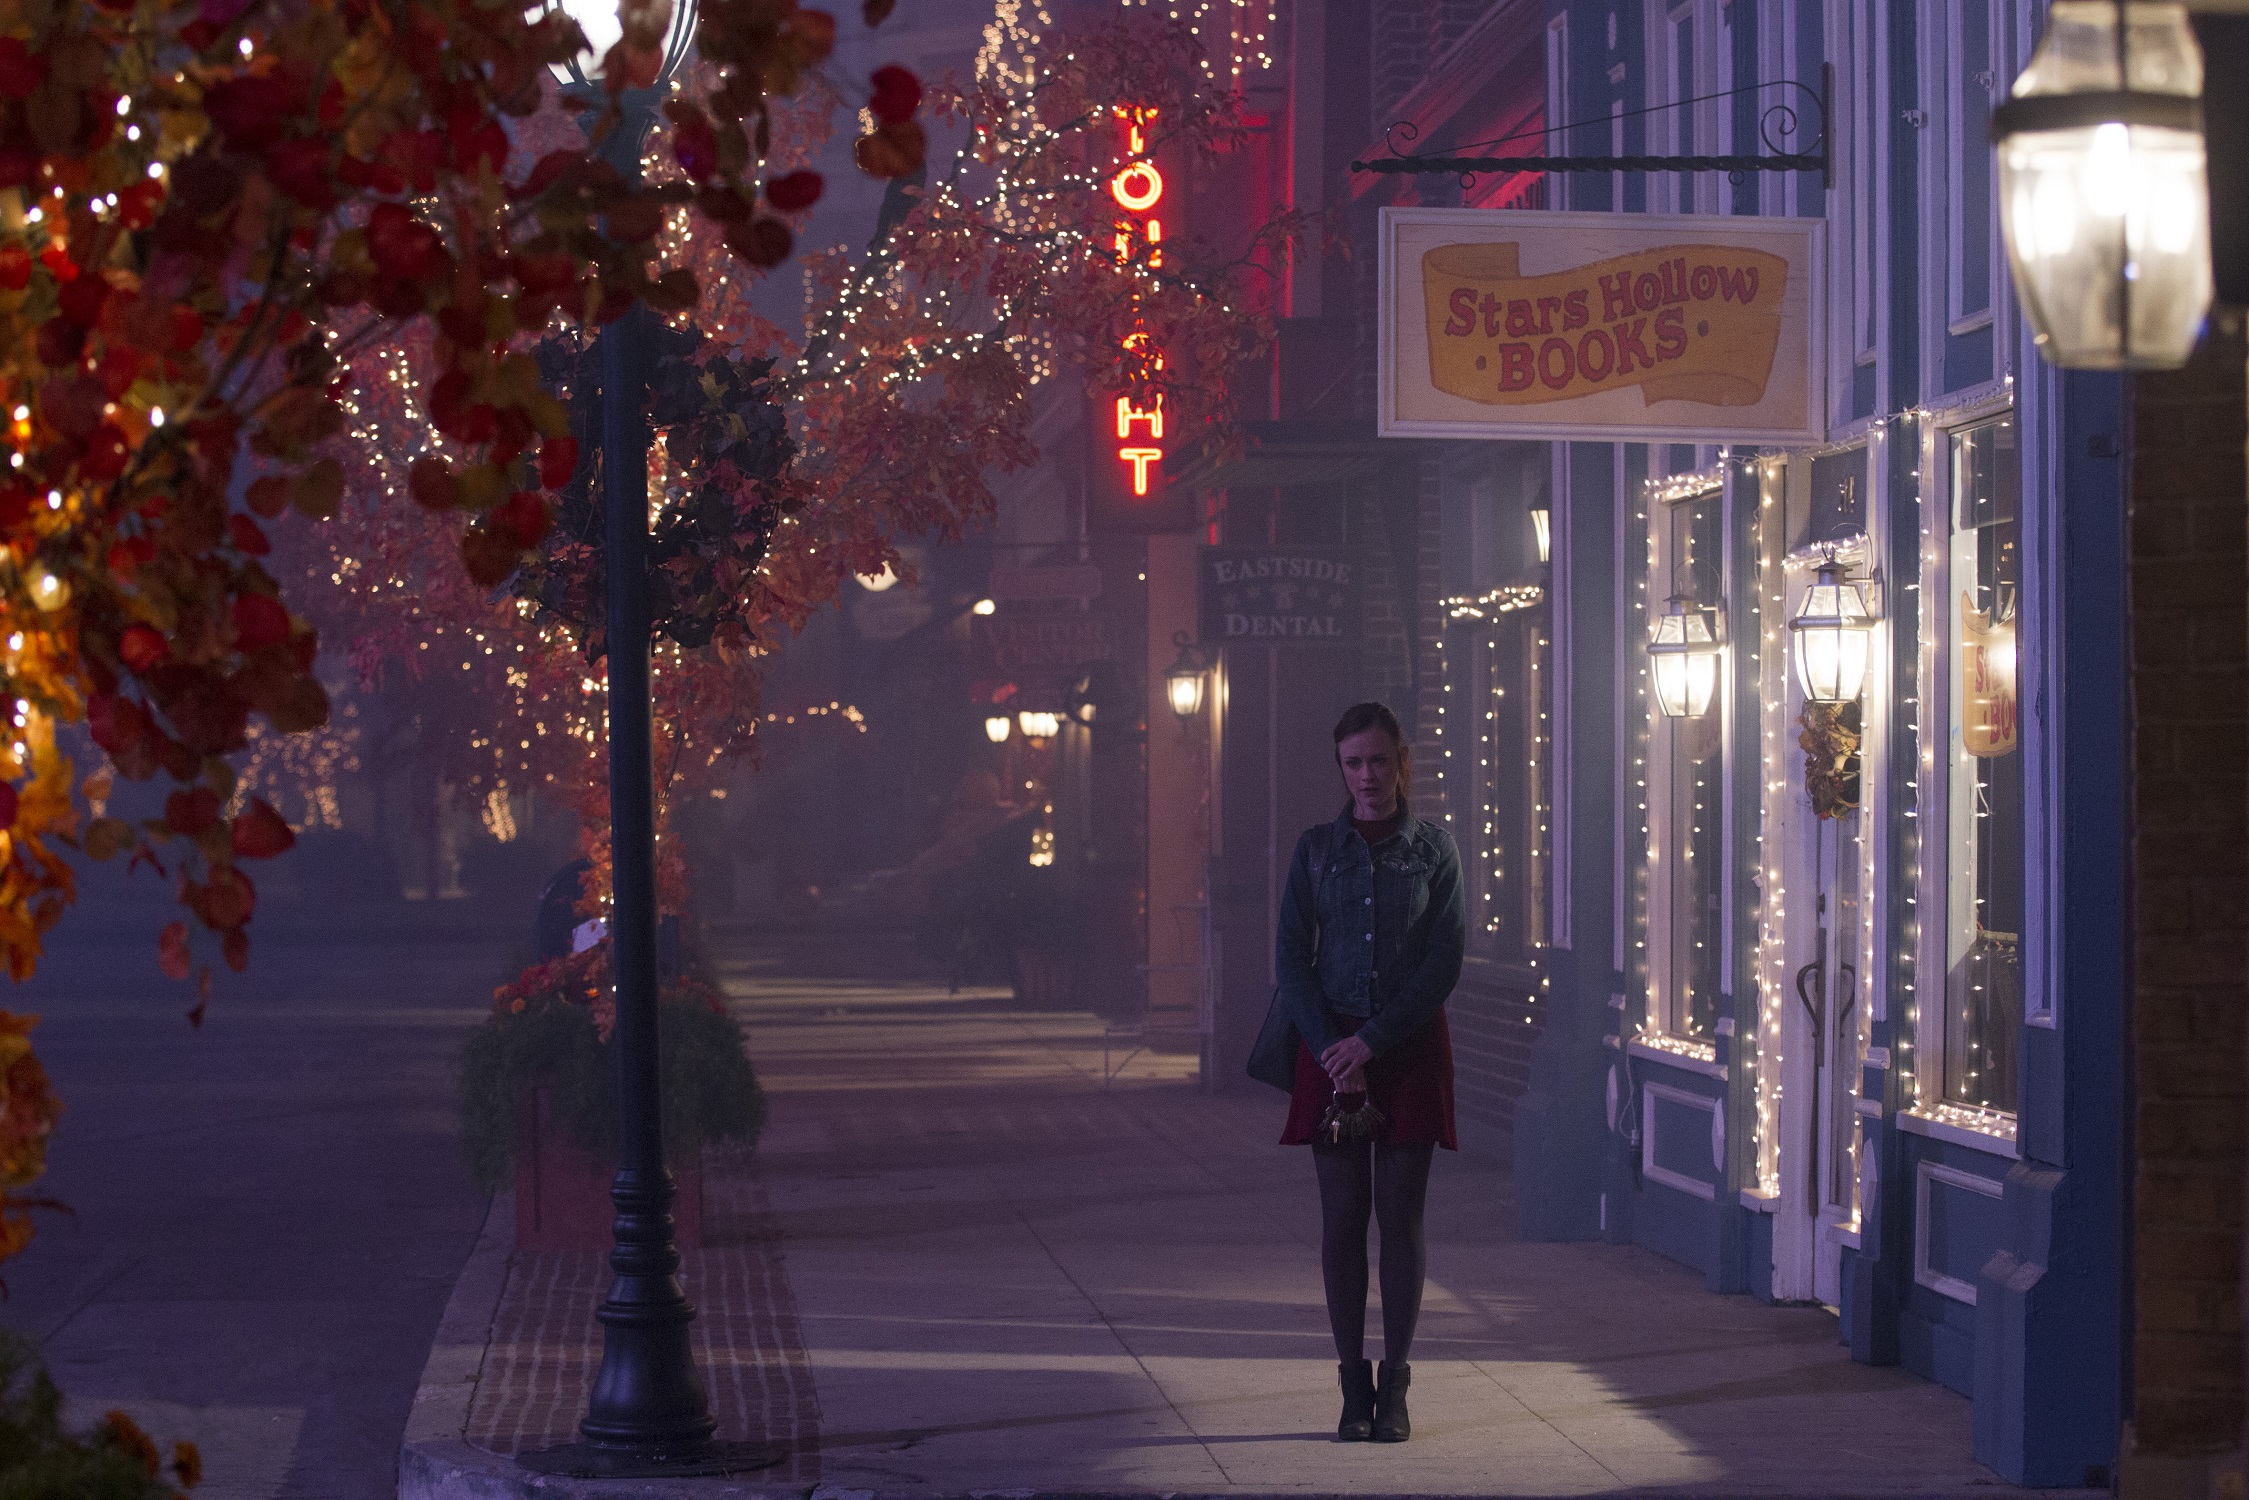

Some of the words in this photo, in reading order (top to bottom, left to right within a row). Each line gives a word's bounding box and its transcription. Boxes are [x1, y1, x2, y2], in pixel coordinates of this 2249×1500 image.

[1444, 287, 1590, 338] Stars
[1598, 257, 1760, 323] Hollow
[1497, 306, 1690, 392] BOOKS
[1212, 556, 1352, 585] EASTSIDE
[1224, 613, 1343, 636] DENTAL
